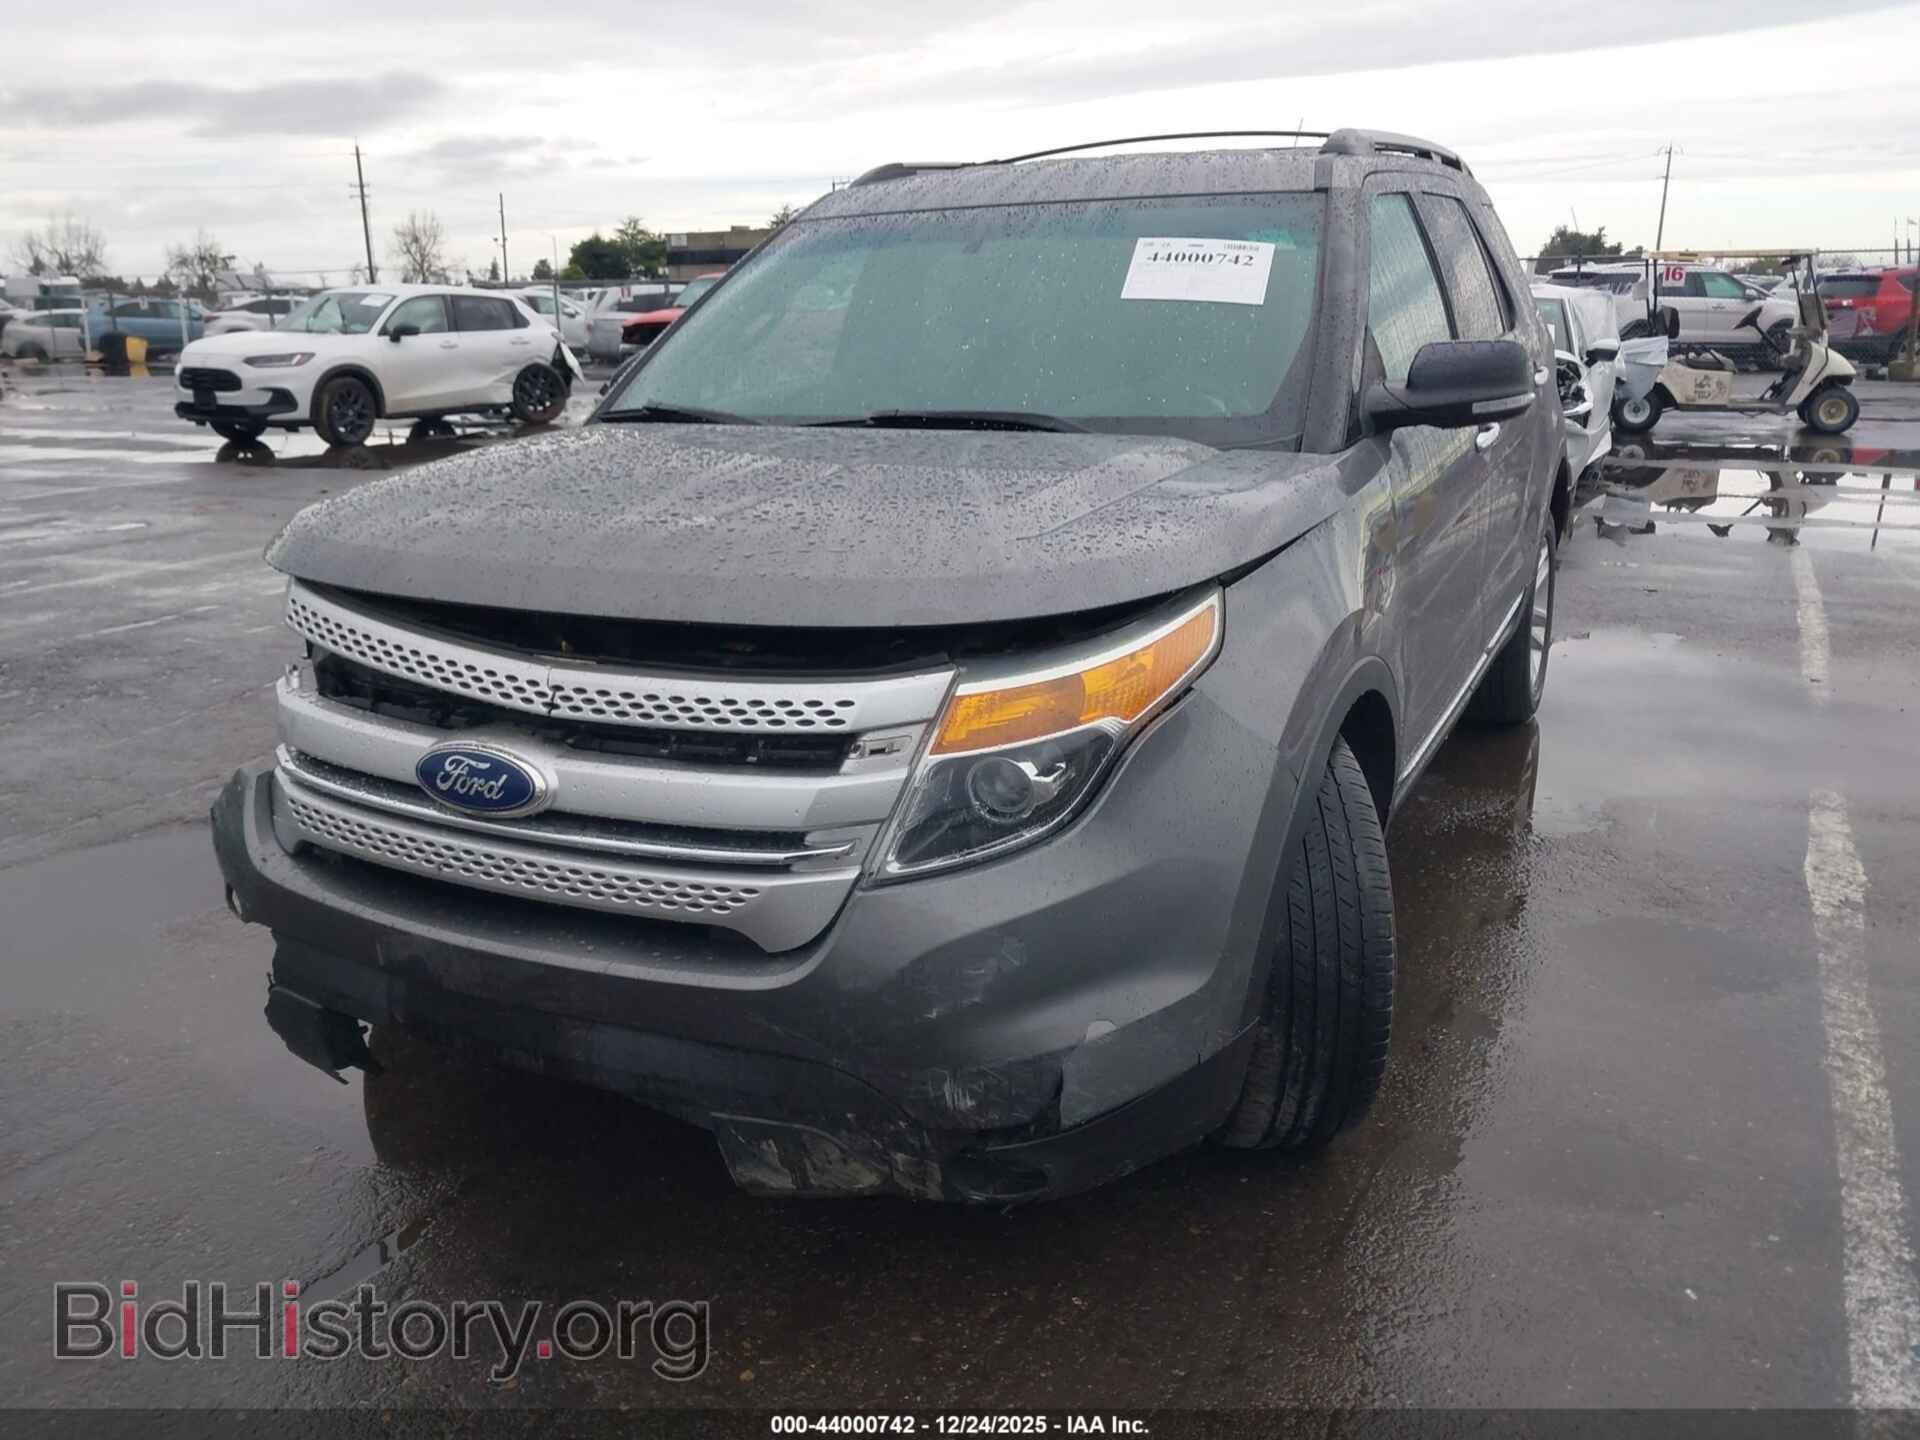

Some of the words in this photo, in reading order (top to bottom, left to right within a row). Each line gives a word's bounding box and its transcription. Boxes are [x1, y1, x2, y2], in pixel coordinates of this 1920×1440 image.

[1146, 251, 1254, 266] 44000742
[1664, 266, 1684, 281] 16
[436, 755, 508, 800] Ford
